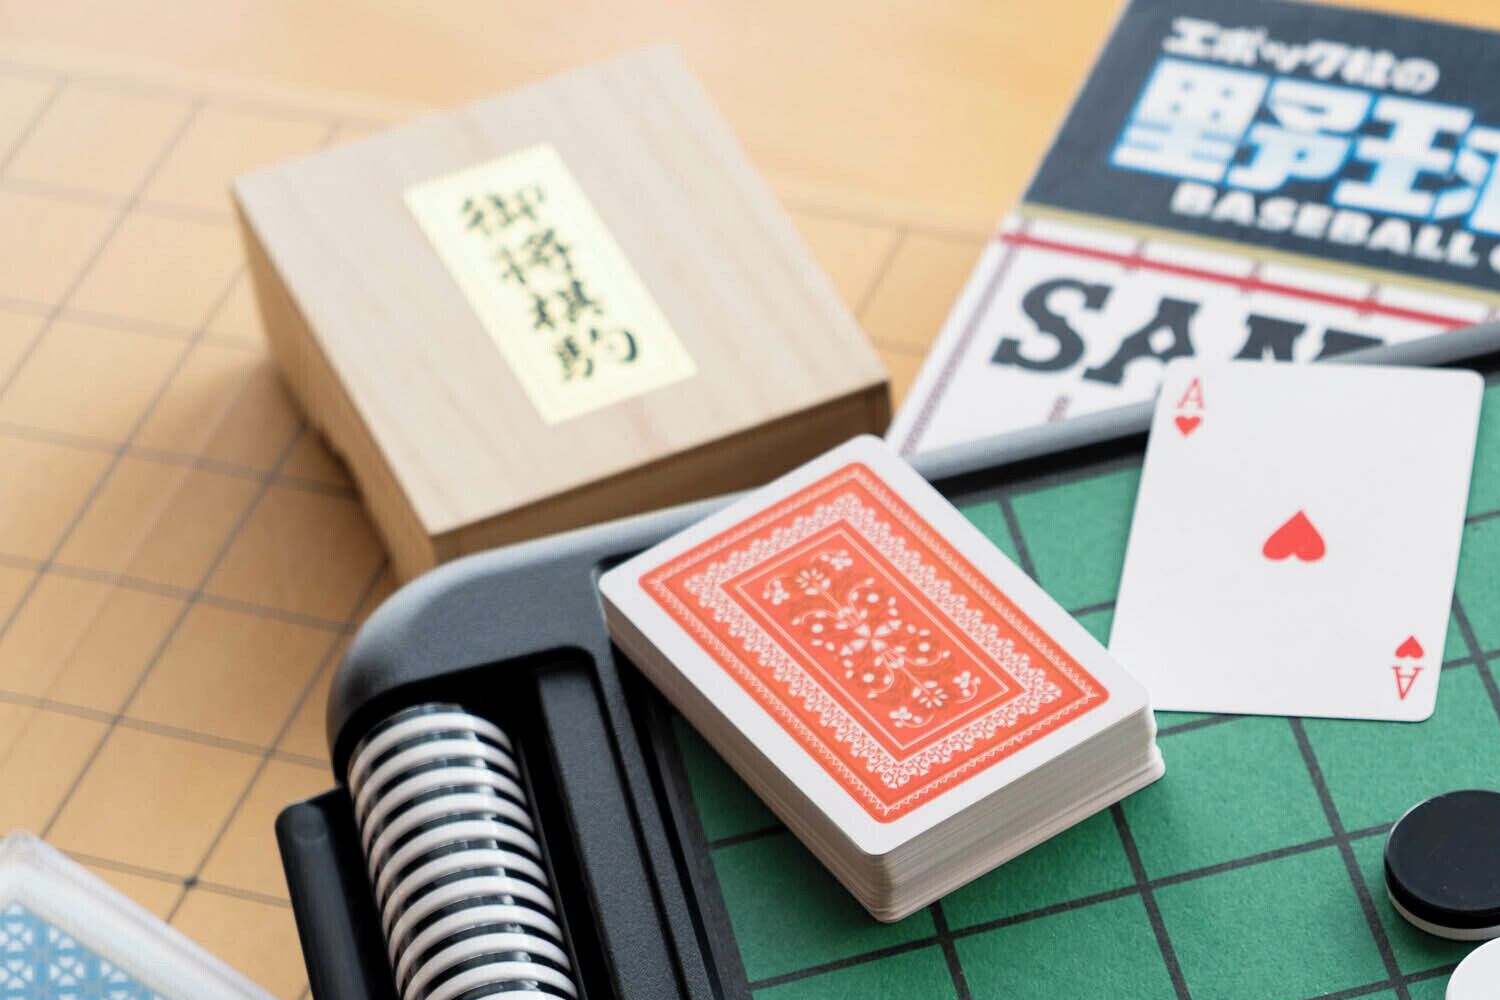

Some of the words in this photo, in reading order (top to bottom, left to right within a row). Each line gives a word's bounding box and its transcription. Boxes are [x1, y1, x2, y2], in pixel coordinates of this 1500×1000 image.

[1171, 181, 1480, 269] BASEBALL
[1177, 377, 1206, 410] A
[1392, 665, 1424, 701] A
